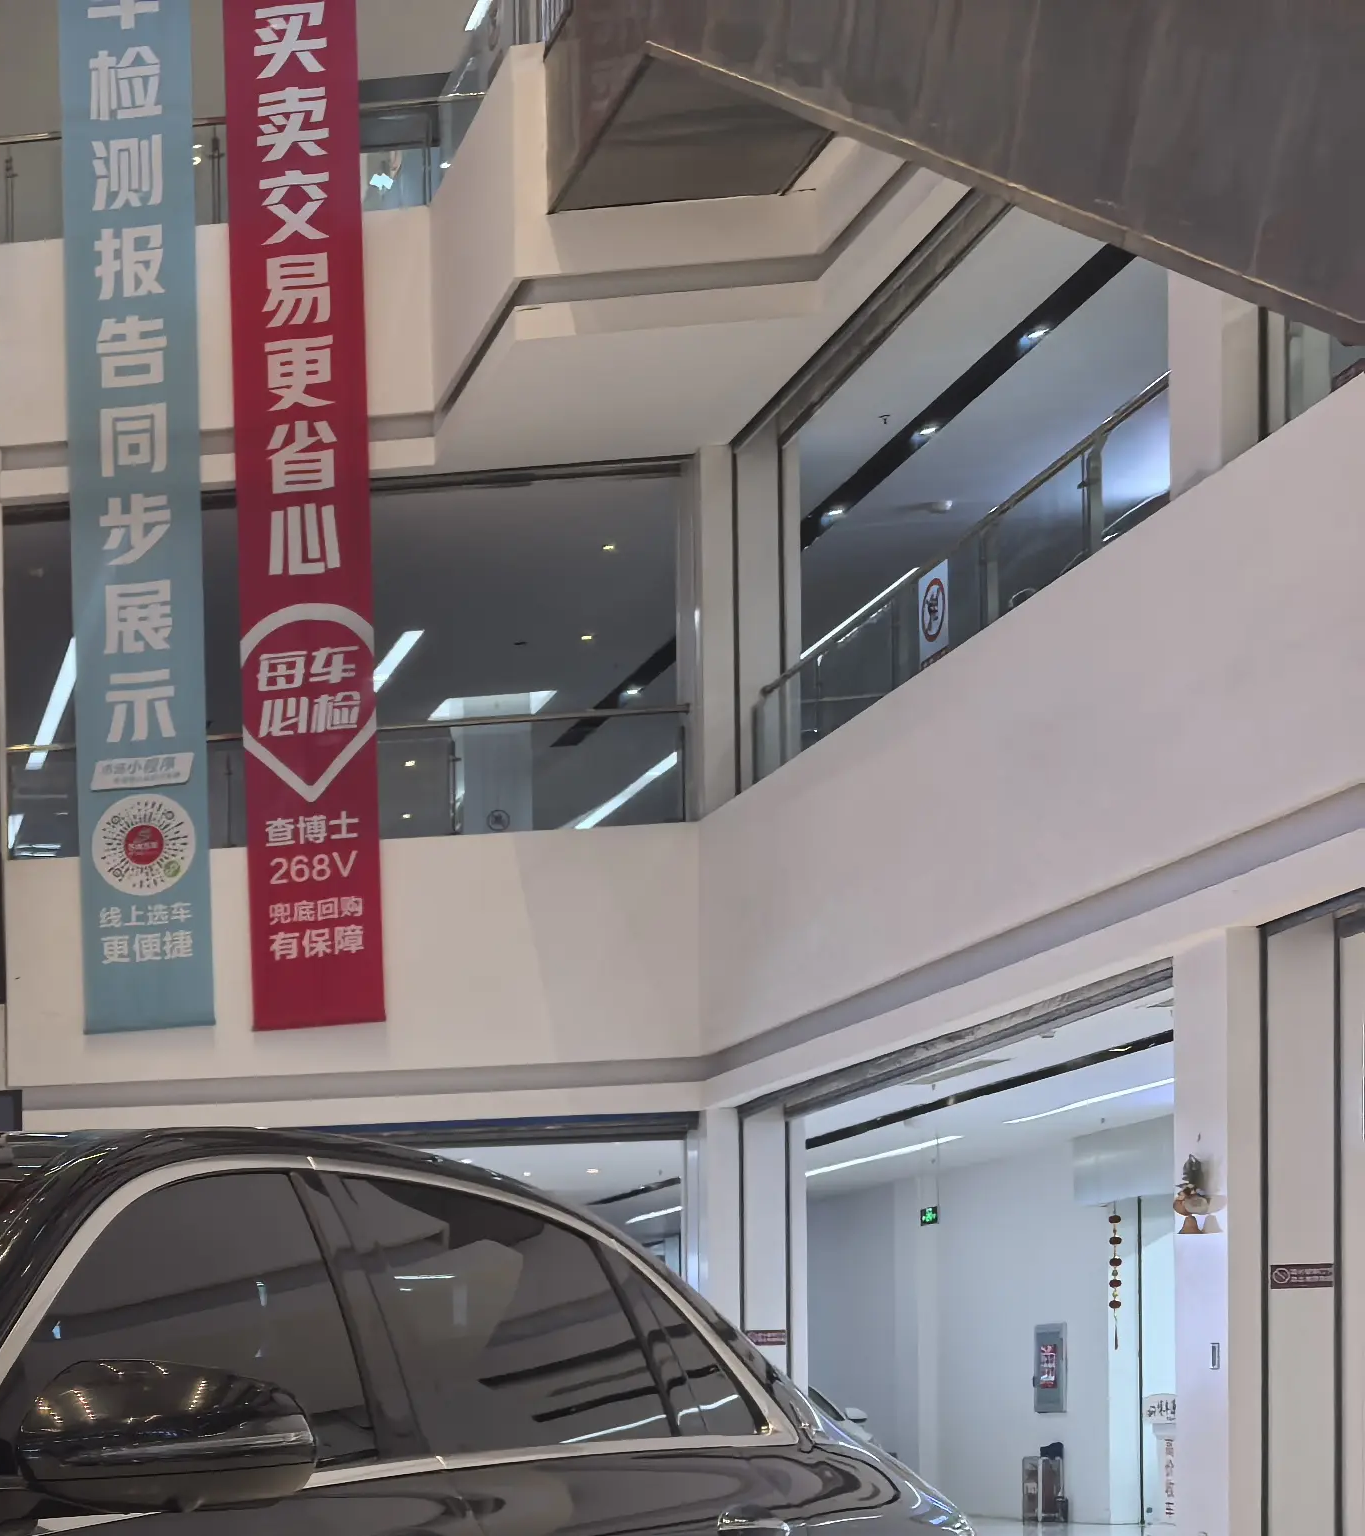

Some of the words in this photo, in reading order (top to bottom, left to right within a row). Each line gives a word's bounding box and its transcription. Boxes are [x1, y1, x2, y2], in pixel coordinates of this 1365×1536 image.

[253, 1, 342, 577] 买卖交易更省心
[265, 810, 360, 848] 查博士
[269, 850, 358, 885] 268V
[99, 902, 192, 928] 线上选车
[269, 896, 364, 926] 兜底回购
[101, 932, 193, 964] 更便捷
[269, 924, 365, 961] 有保障
